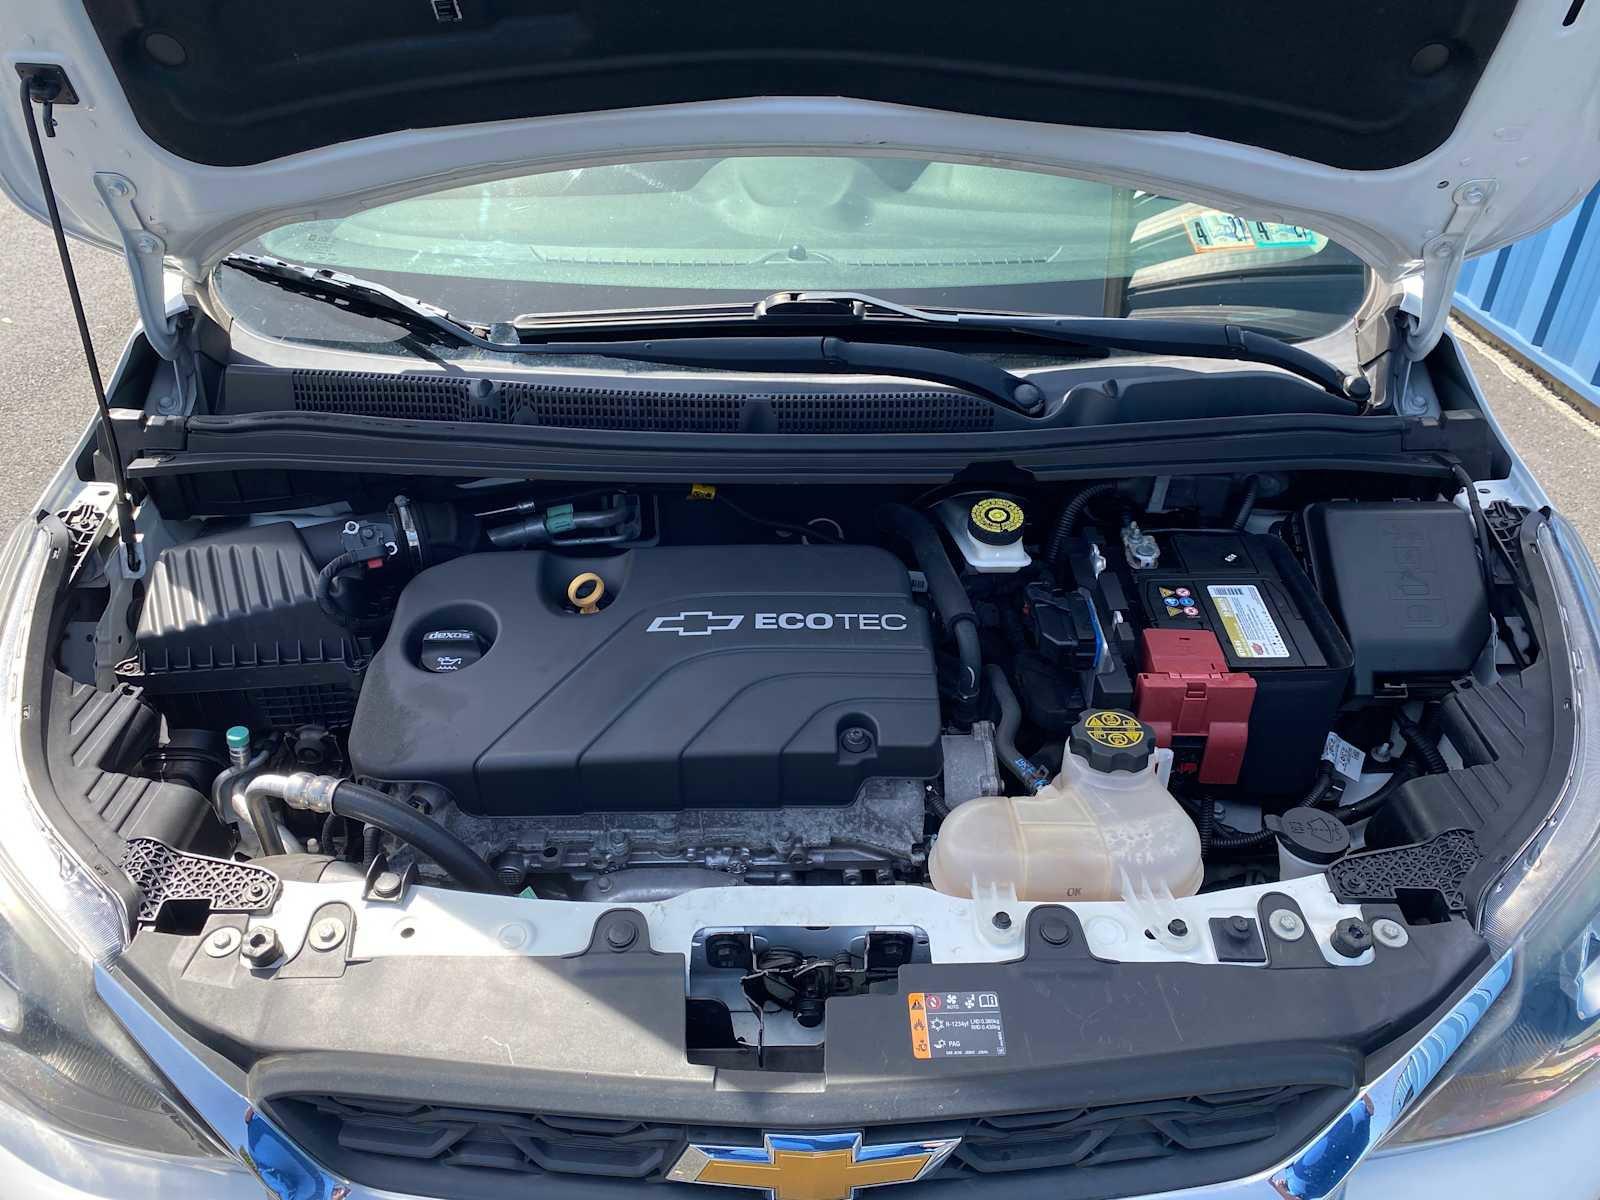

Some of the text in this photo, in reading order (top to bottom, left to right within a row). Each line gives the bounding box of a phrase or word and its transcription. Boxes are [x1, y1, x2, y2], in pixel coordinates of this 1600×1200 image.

[1194, 221, 1210, 245] 4
[1255, 221, 1270, 241] 4
[754, 612, 908, 631] ECOTEC
[428, 631, 471, 639] dexos
